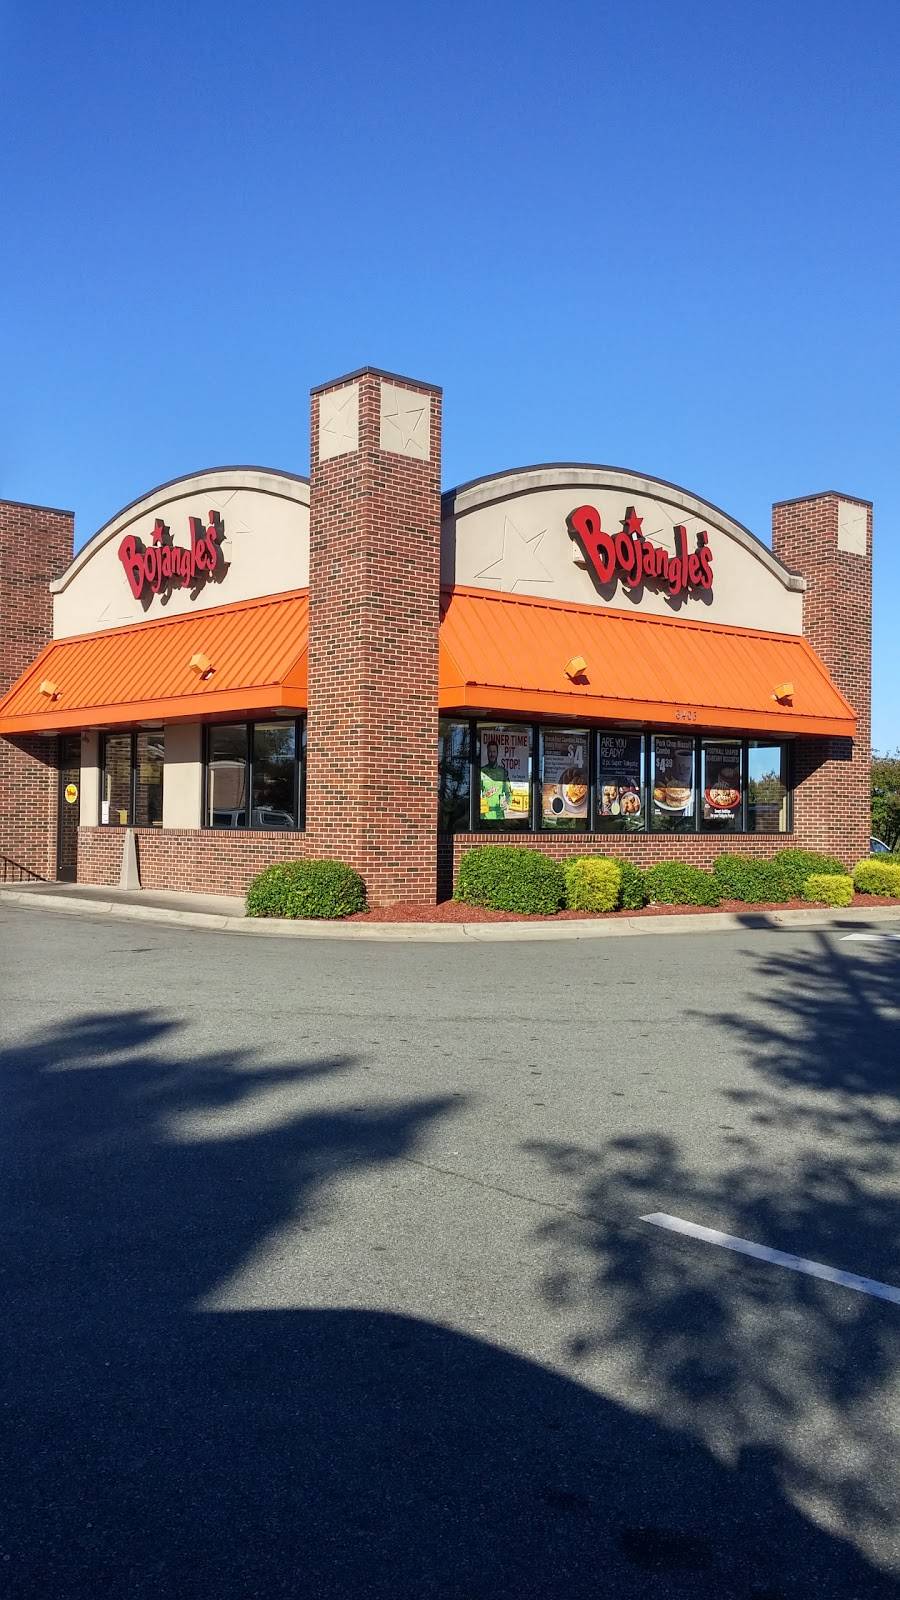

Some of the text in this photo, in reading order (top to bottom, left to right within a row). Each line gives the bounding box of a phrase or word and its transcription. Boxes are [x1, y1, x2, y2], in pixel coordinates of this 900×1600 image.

[483, 733, 528, 747] DINNER TIME
[601, 737, 627, 748] ARE YOU
[504, 746, 516, 758] PIT
[601, 747, 625, 758] READY?
[501, 758, 521, 770] STOP!
